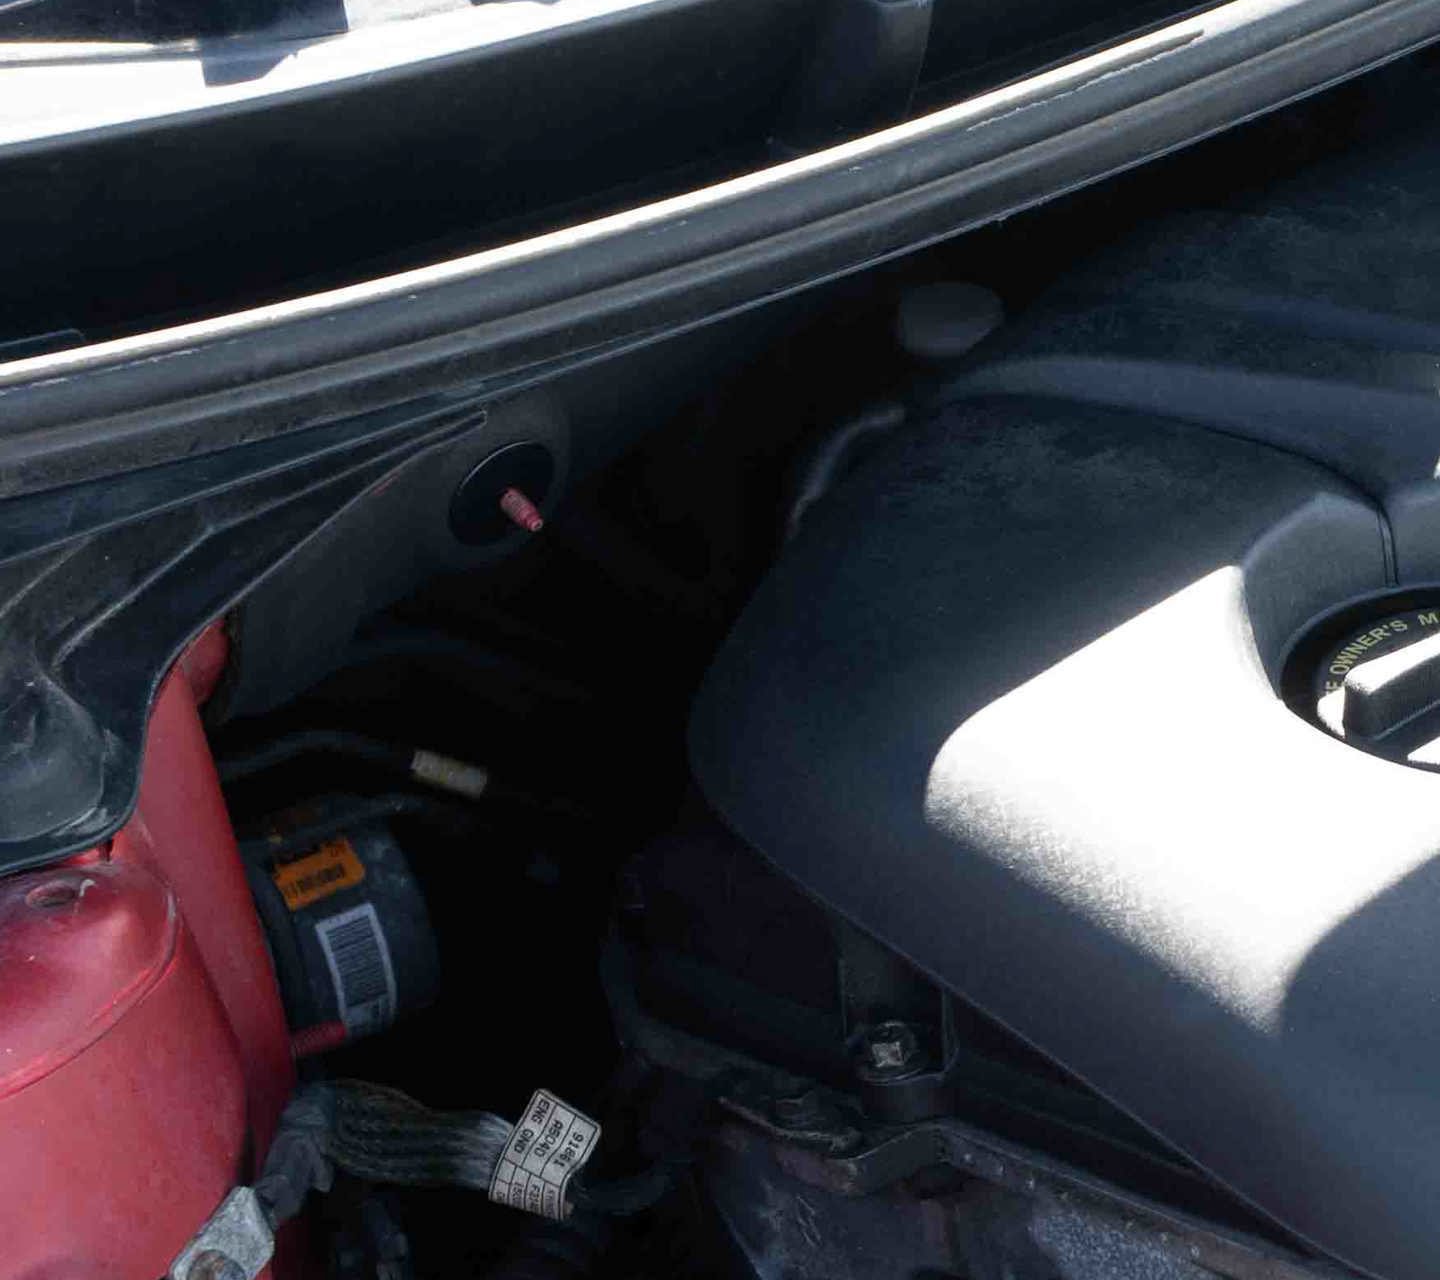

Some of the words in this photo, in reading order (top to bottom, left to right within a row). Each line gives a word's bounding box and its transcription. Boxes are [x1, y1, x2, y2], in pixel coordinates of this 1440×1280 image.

[1329, 619, 1408, 675] OWNER'S
[530, 1099, 551, 1125] ENG
[513, 1127, 535, 1154] GND
